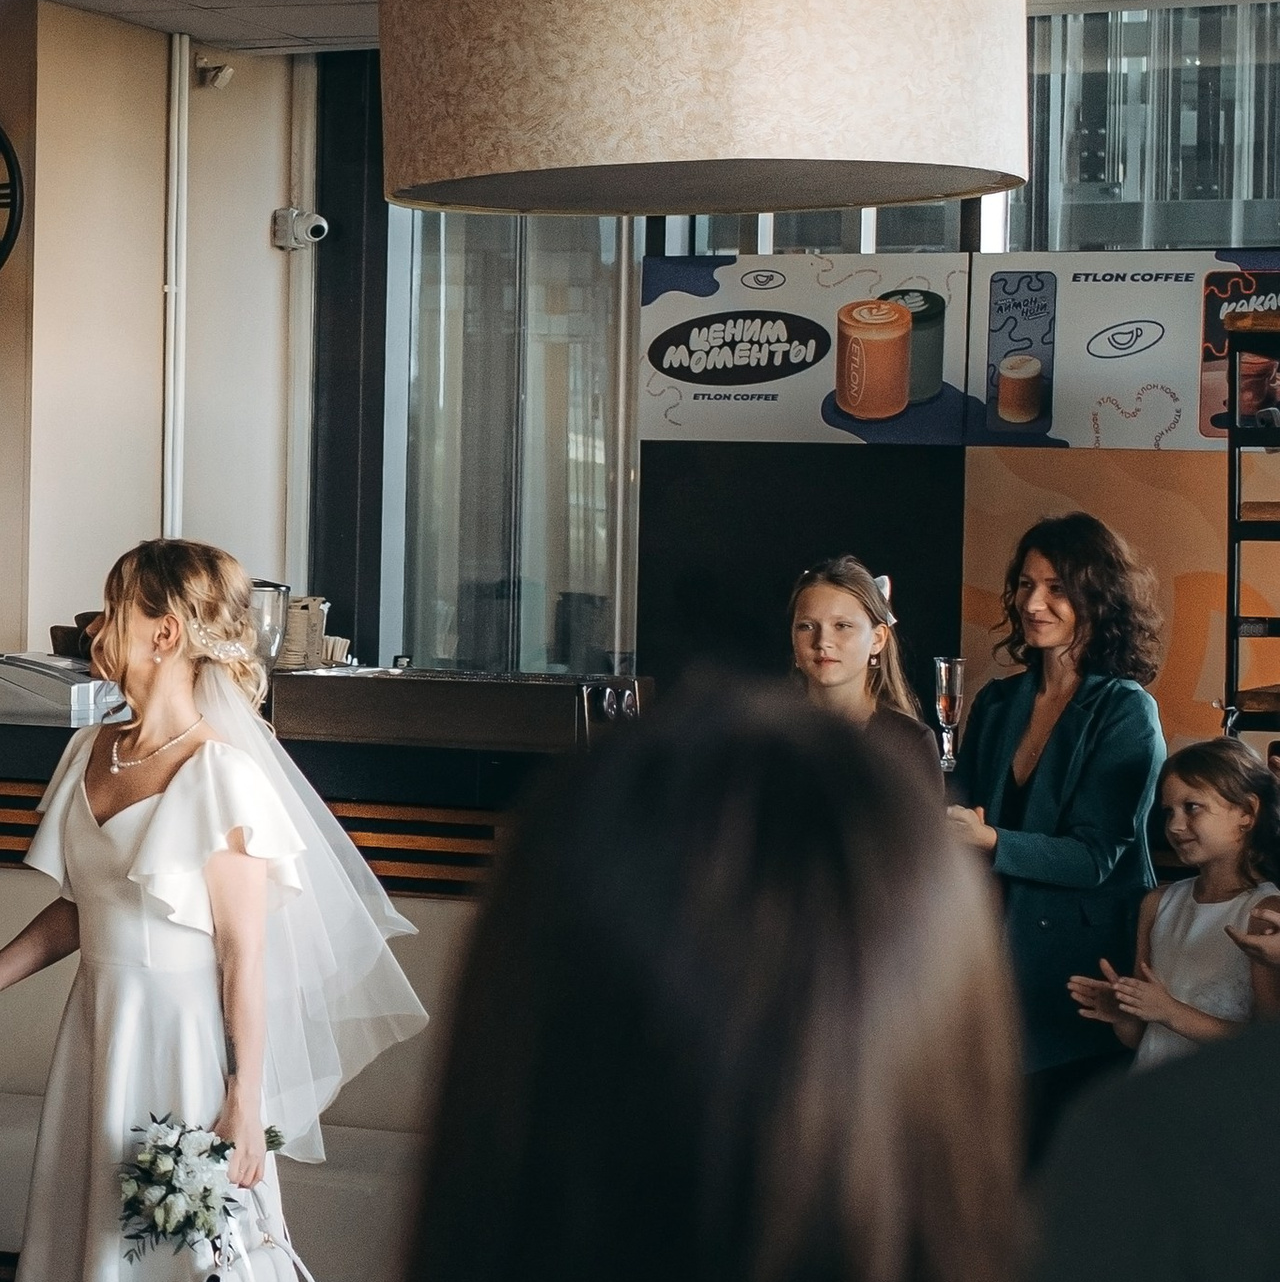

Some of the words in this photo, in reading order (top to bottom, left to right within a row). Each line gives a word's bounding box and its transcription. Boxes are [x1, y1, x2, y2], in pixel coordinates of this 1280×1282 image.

[1072, 273, 1127, 283] ETLON
[1130, 273, 1195, 283] COFFEE
[689, 318, 788, 351] ЦЕНИМ
[663, 339, 816, 374] МОМЕНТЫ
[850, 342, 860, 398] ETLON
[693, 393, 732, 401] ETLON
[733, 393, 779, 401] COFFEE
[1153, 430, 1166, 450] КОФ
